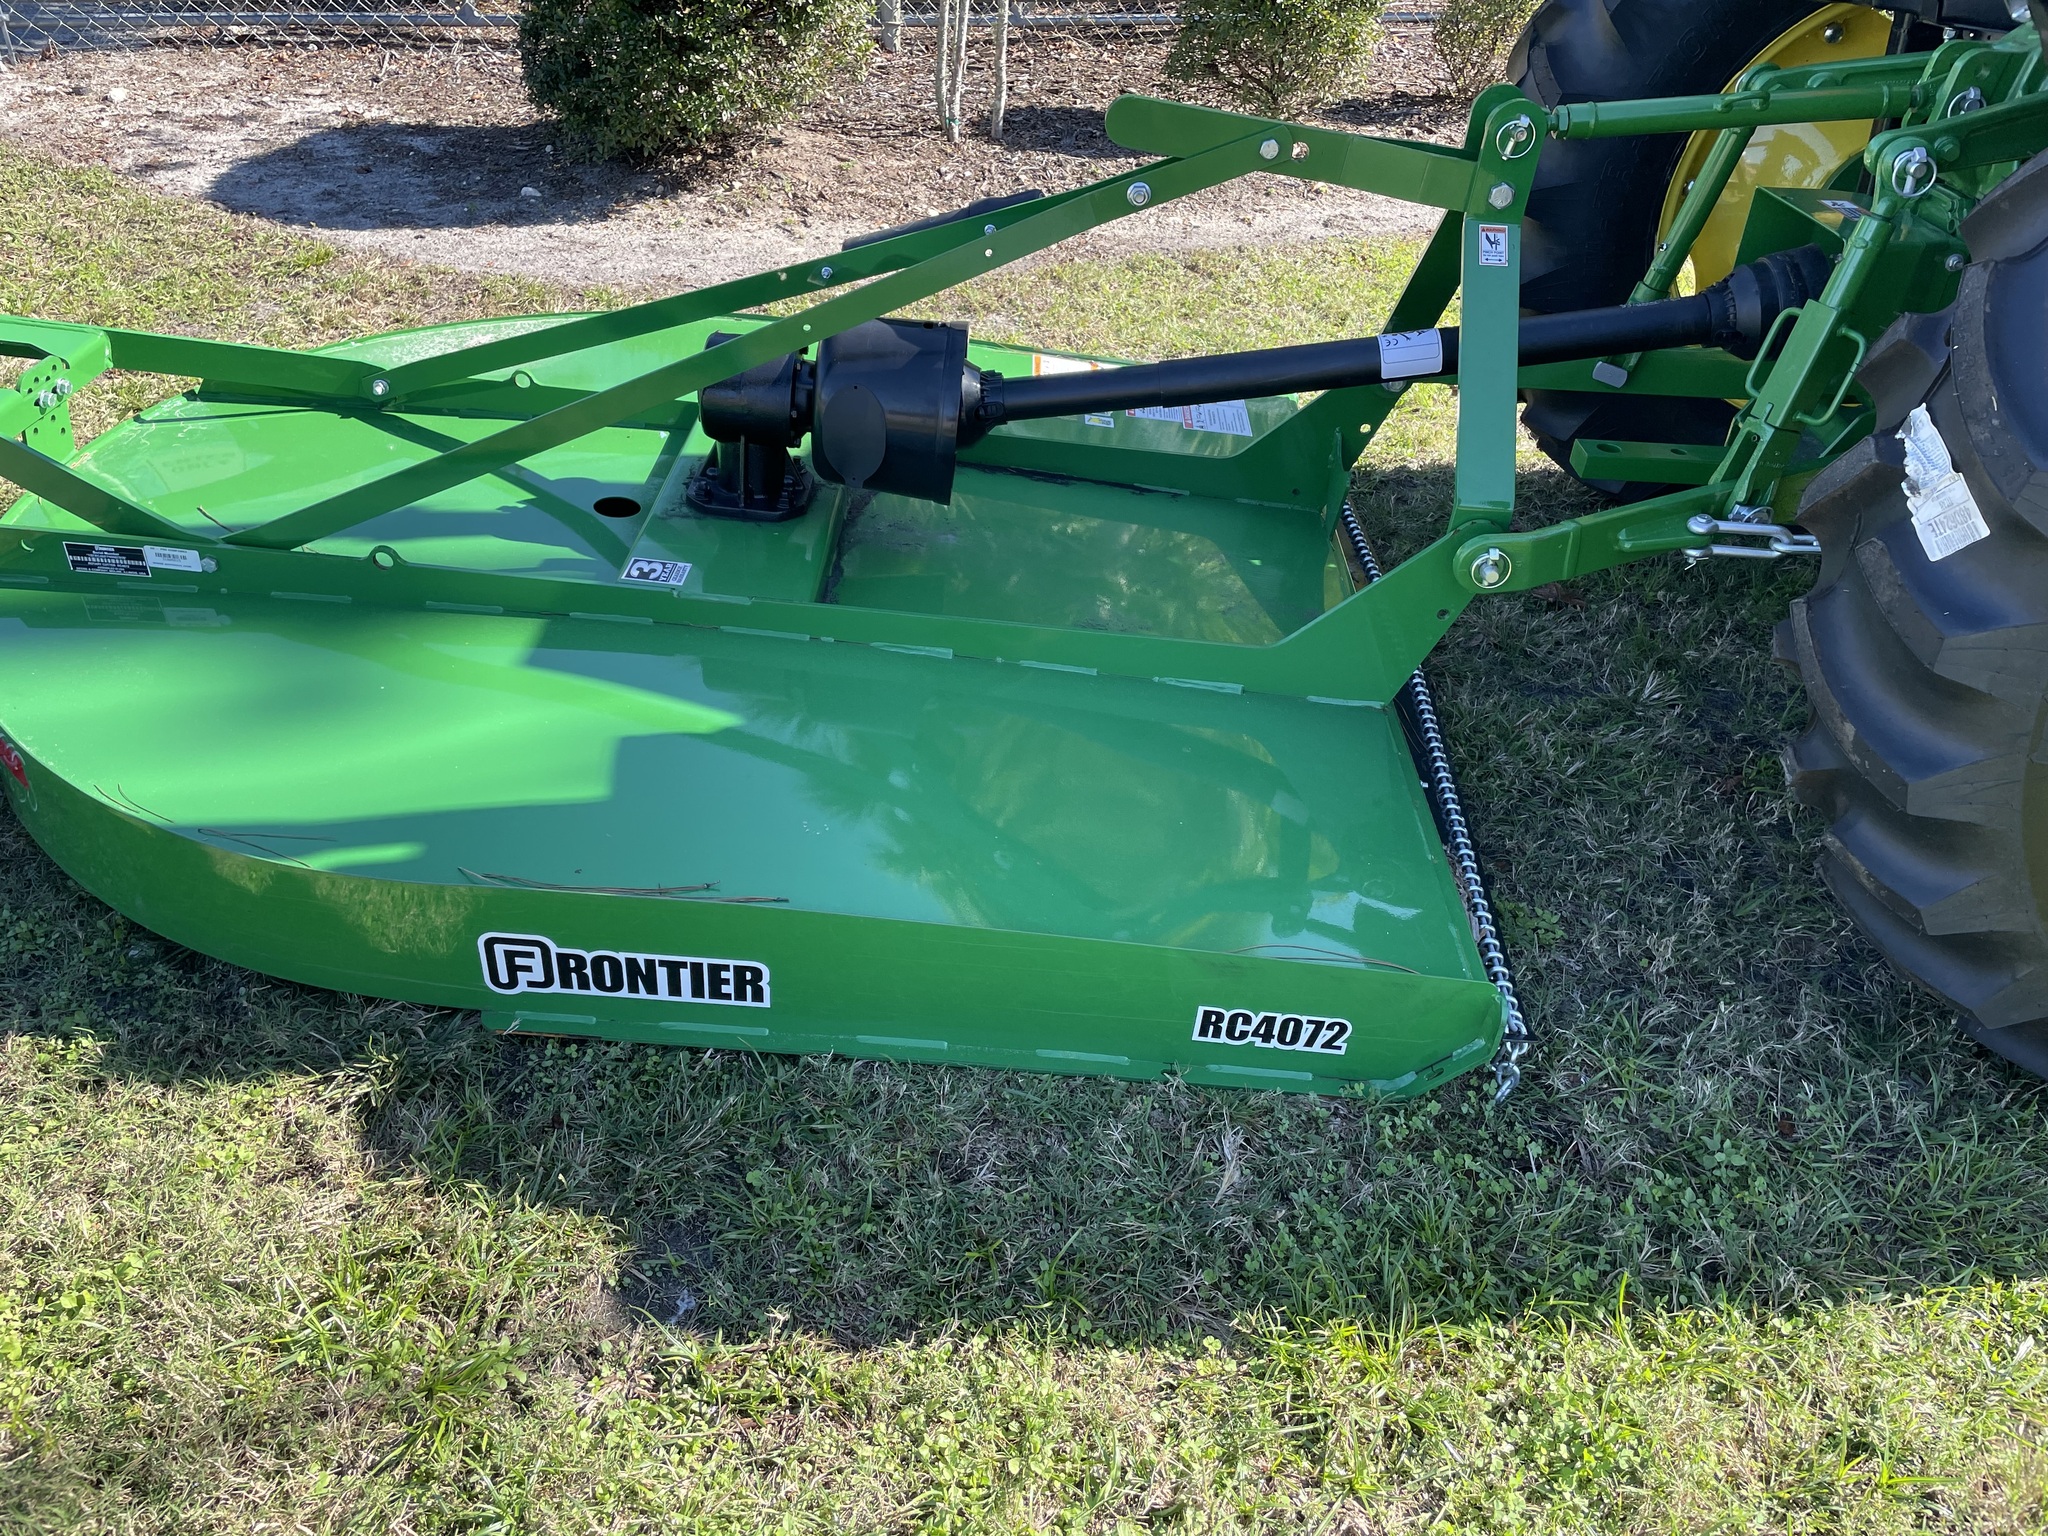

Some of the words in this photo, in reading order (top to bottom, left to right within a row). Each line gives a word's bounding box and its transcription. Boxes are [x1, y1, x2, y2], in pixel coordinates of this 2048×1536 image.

[629, 560, 663, 580] 3
[659, 563, 674, 581] YEAR
[484, 936, 764, 1003] FRONTIER
[1198, 1010, 1348, 1051] RC4072
